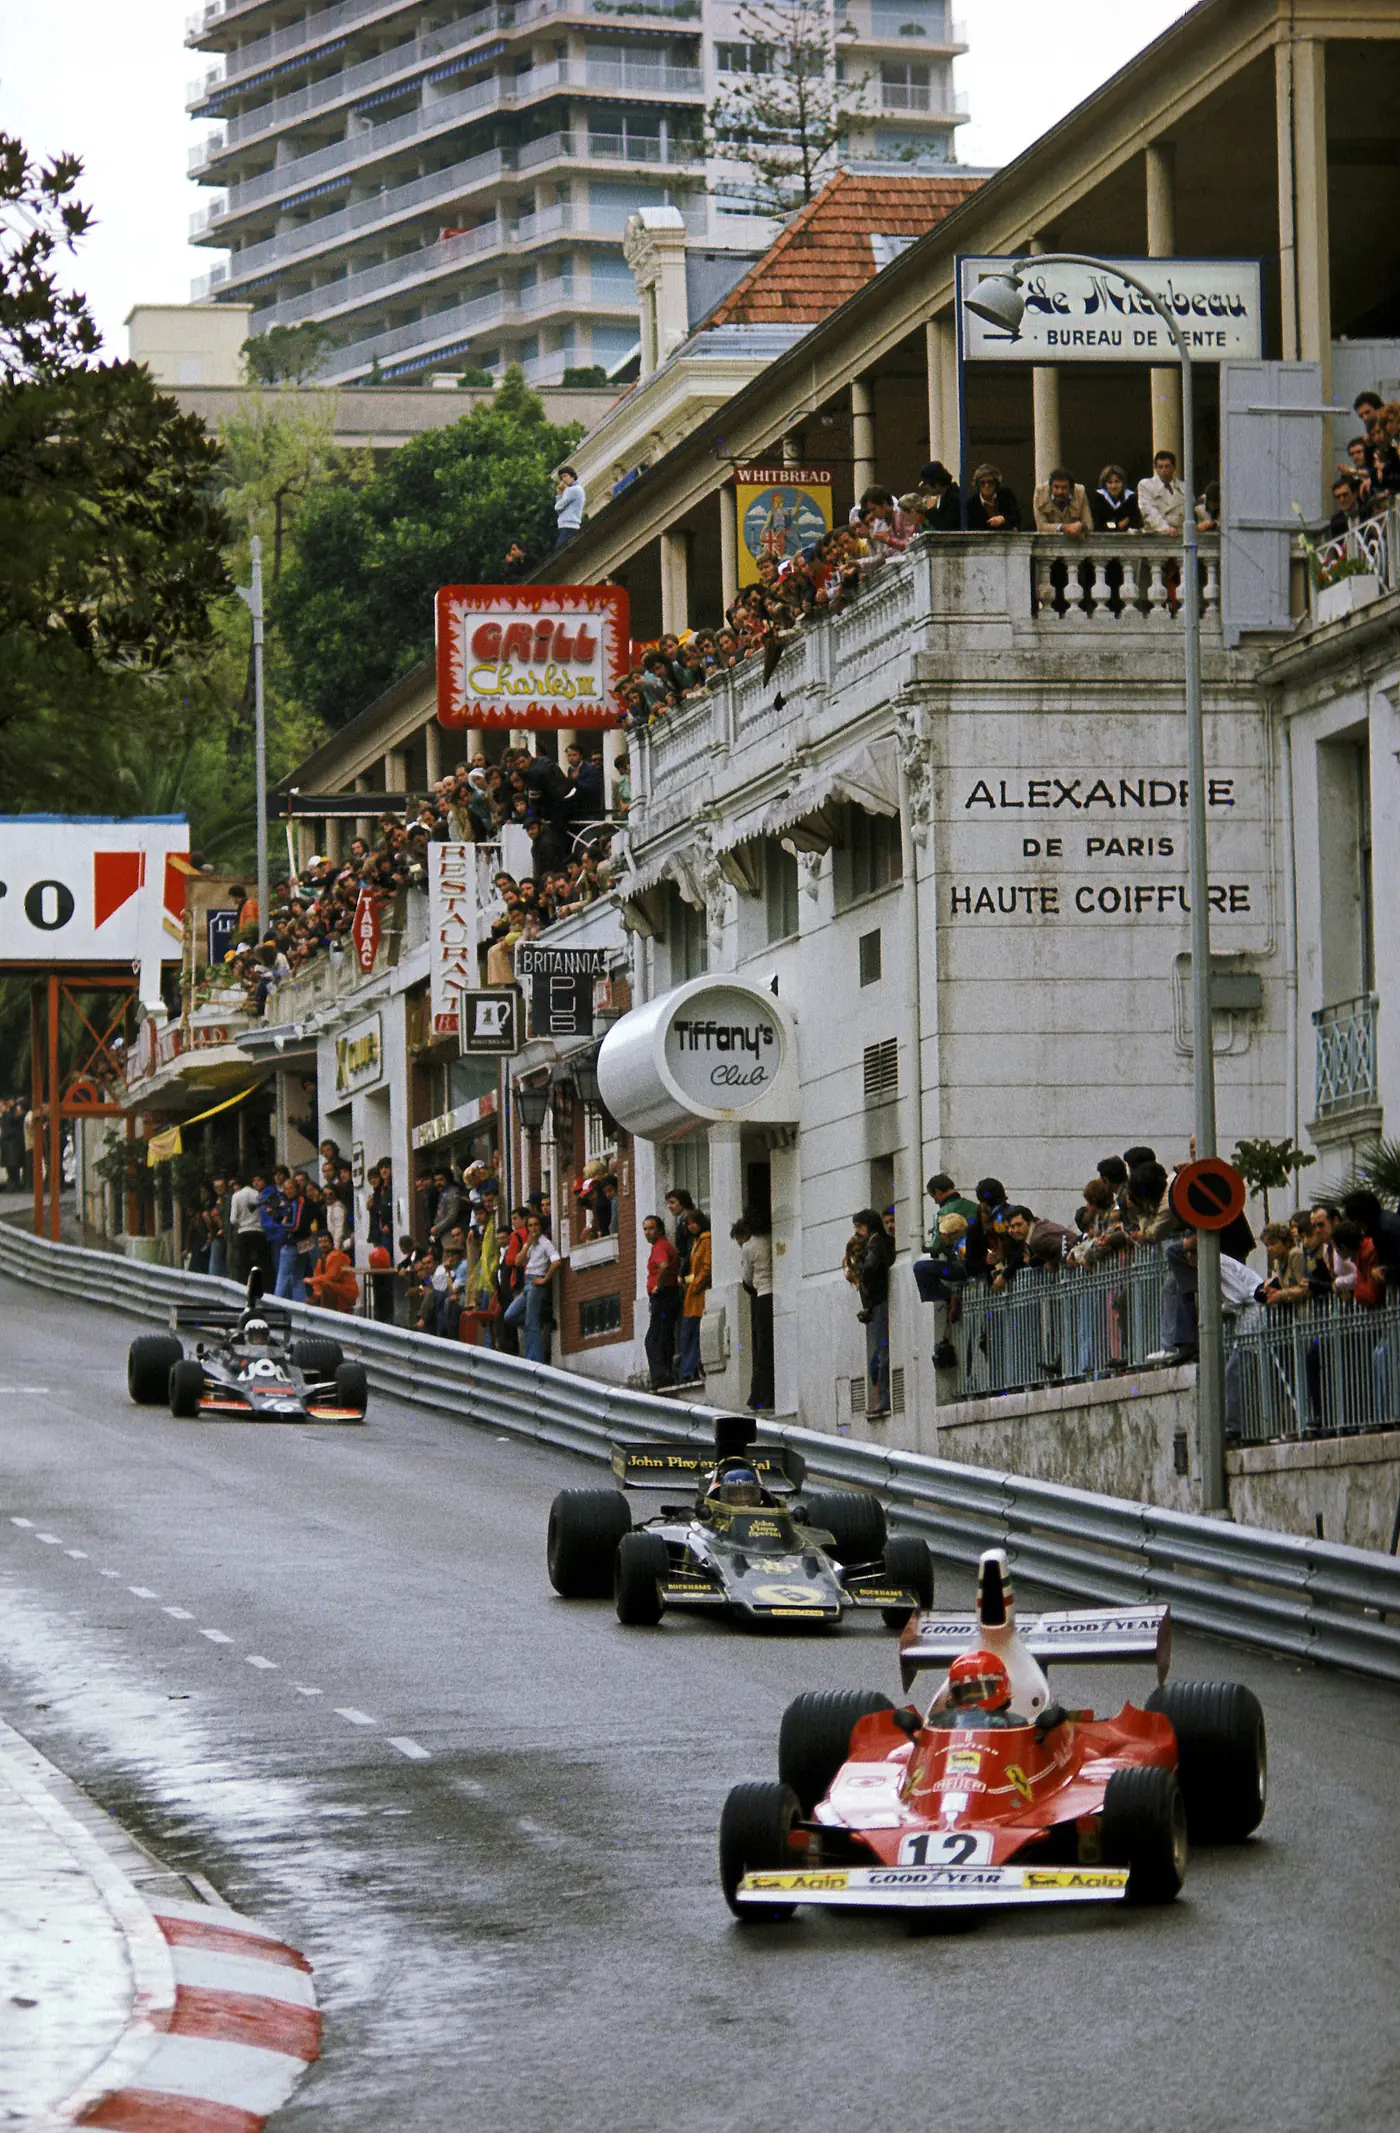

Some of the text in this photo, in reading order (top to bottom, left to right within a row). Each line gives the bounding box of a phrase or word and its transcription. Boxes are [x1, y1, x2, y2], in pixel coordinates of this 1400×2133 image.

[1025, 276, 1072, 315] Le
[1047, 330, 1122, 346] BUREAU
[1134, 331, 1157, 346] DE
[737, 470, 831, 482] WHITBREAD
[468, 662, 597, 699] Charles III
[1023, 838, 1174, 857] DE PARIS
[951, 886, 1059, 914] HAUTE
[360, 897, 374, 966] TABAC
[439, 845, 469, 1010] RESTAURANT
[523, 951, 601, 974] BRITANNIA
[550, 976, 576, 1032] PUB
[674, 1021, 774, 1060] Tiffany's
[710, 1065, 769, 1085] Club
[628, 1455, 663, 1467] John
[908, 1834, 978, 1866] 12
[790, 1875, 846, 1890] Agip
